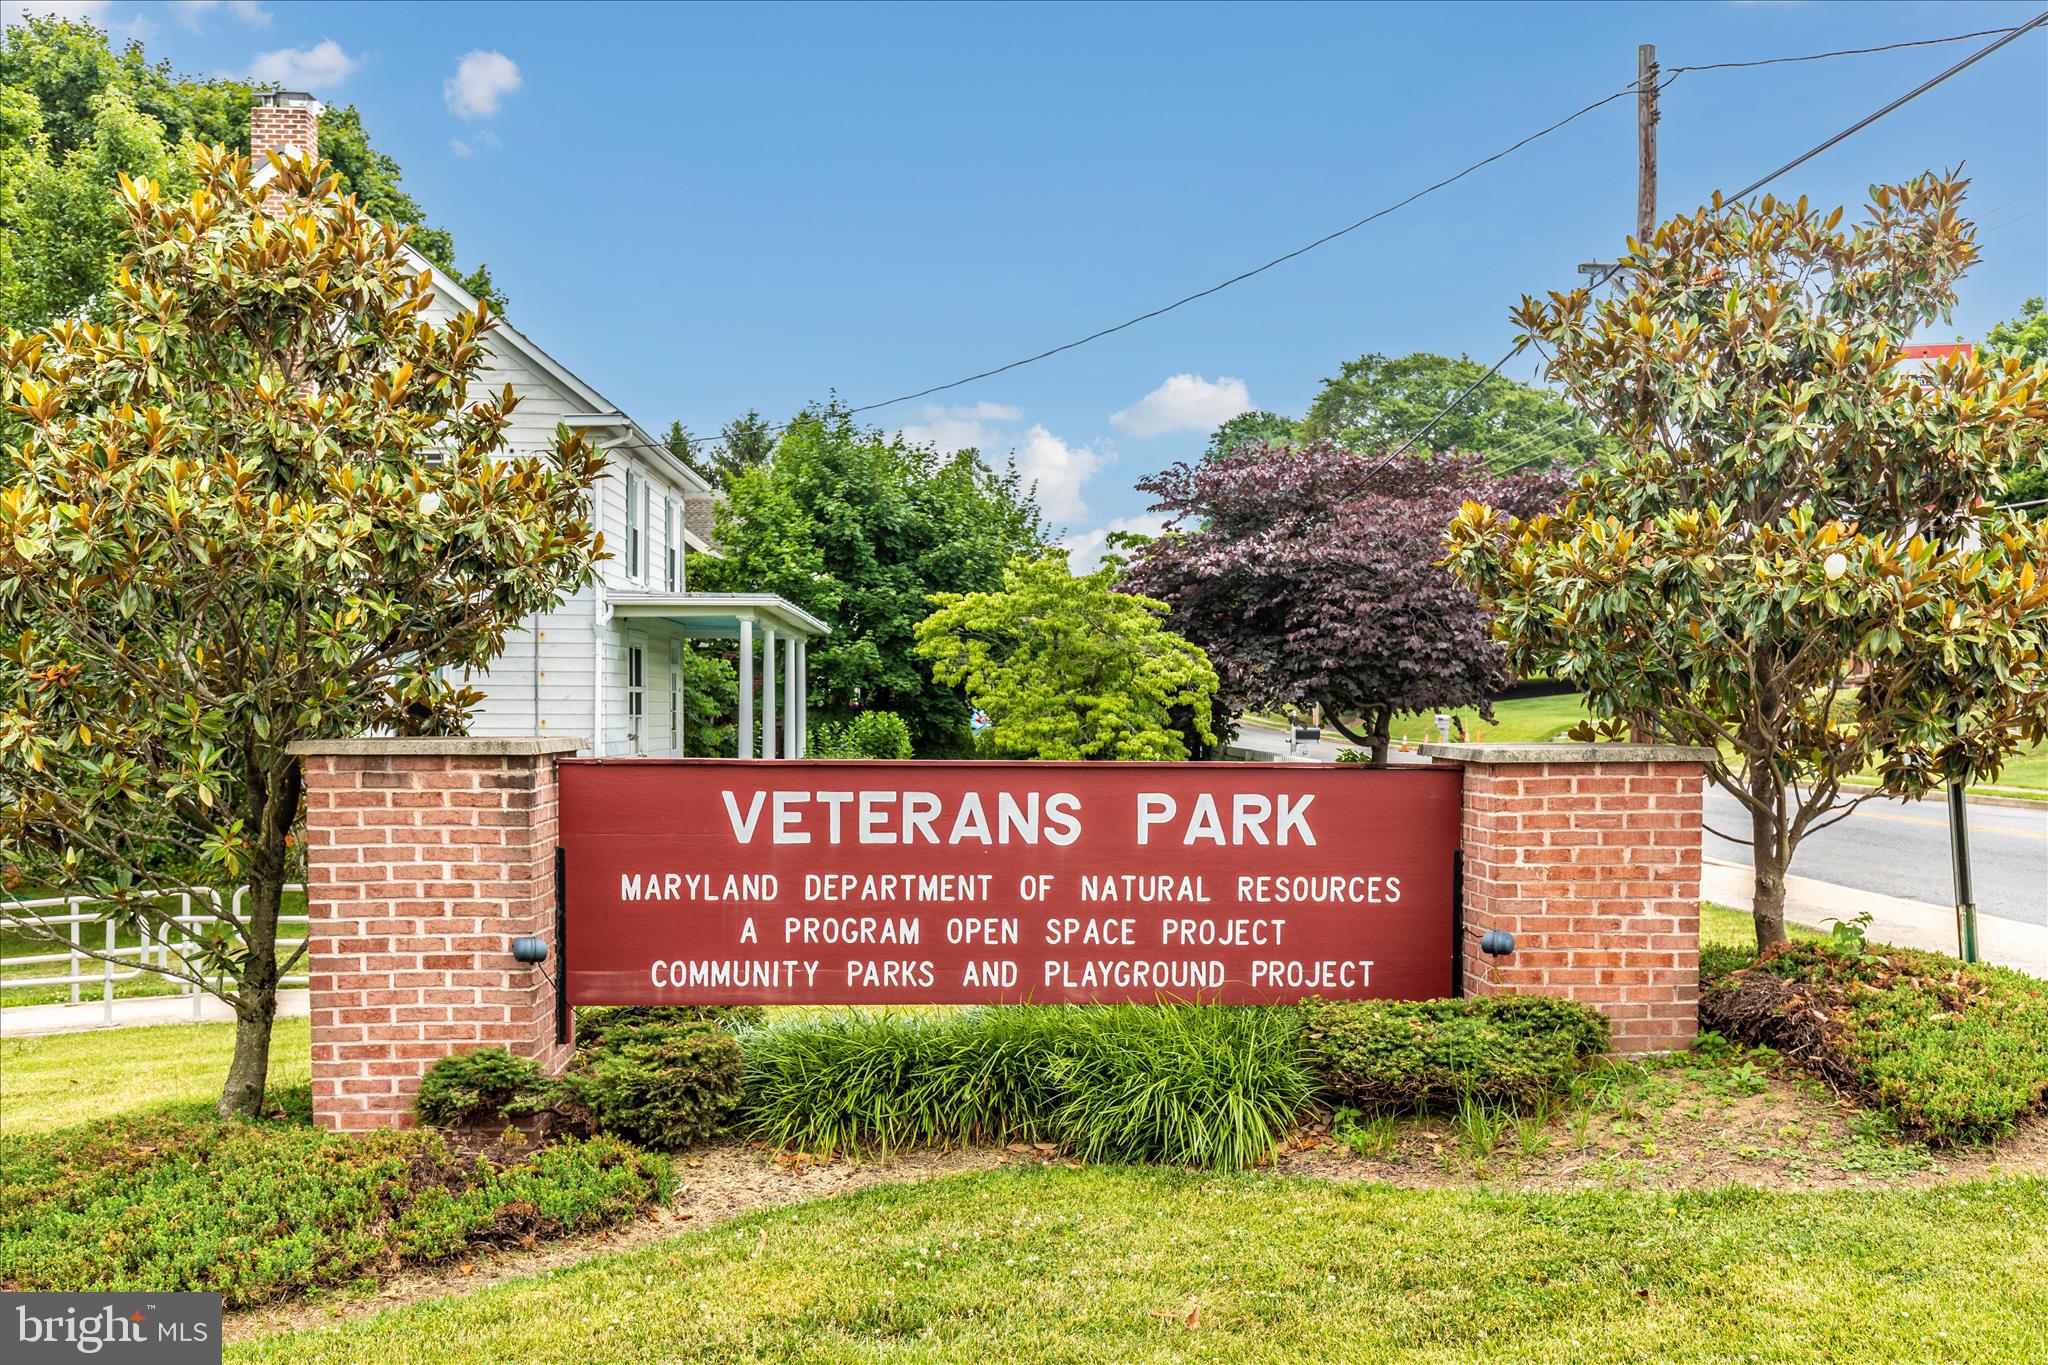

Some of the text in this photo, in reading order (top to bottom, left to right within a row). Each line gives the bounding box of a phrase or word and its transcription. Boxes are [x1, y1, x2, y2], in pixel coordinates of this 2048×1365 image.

[722, 791, 1316, 846] VETERANS PARK
[621, 874, 1401, 904] MARYLAND DEPARTMENT OF NATURAL RESOURCES
[740, 917, 1286, 946] A PROGRAM OPEN SPACE PROJECT
[651, 959, 1375, 988] COMMUNITY PARKS AND PLAYGROUND PROJECT
